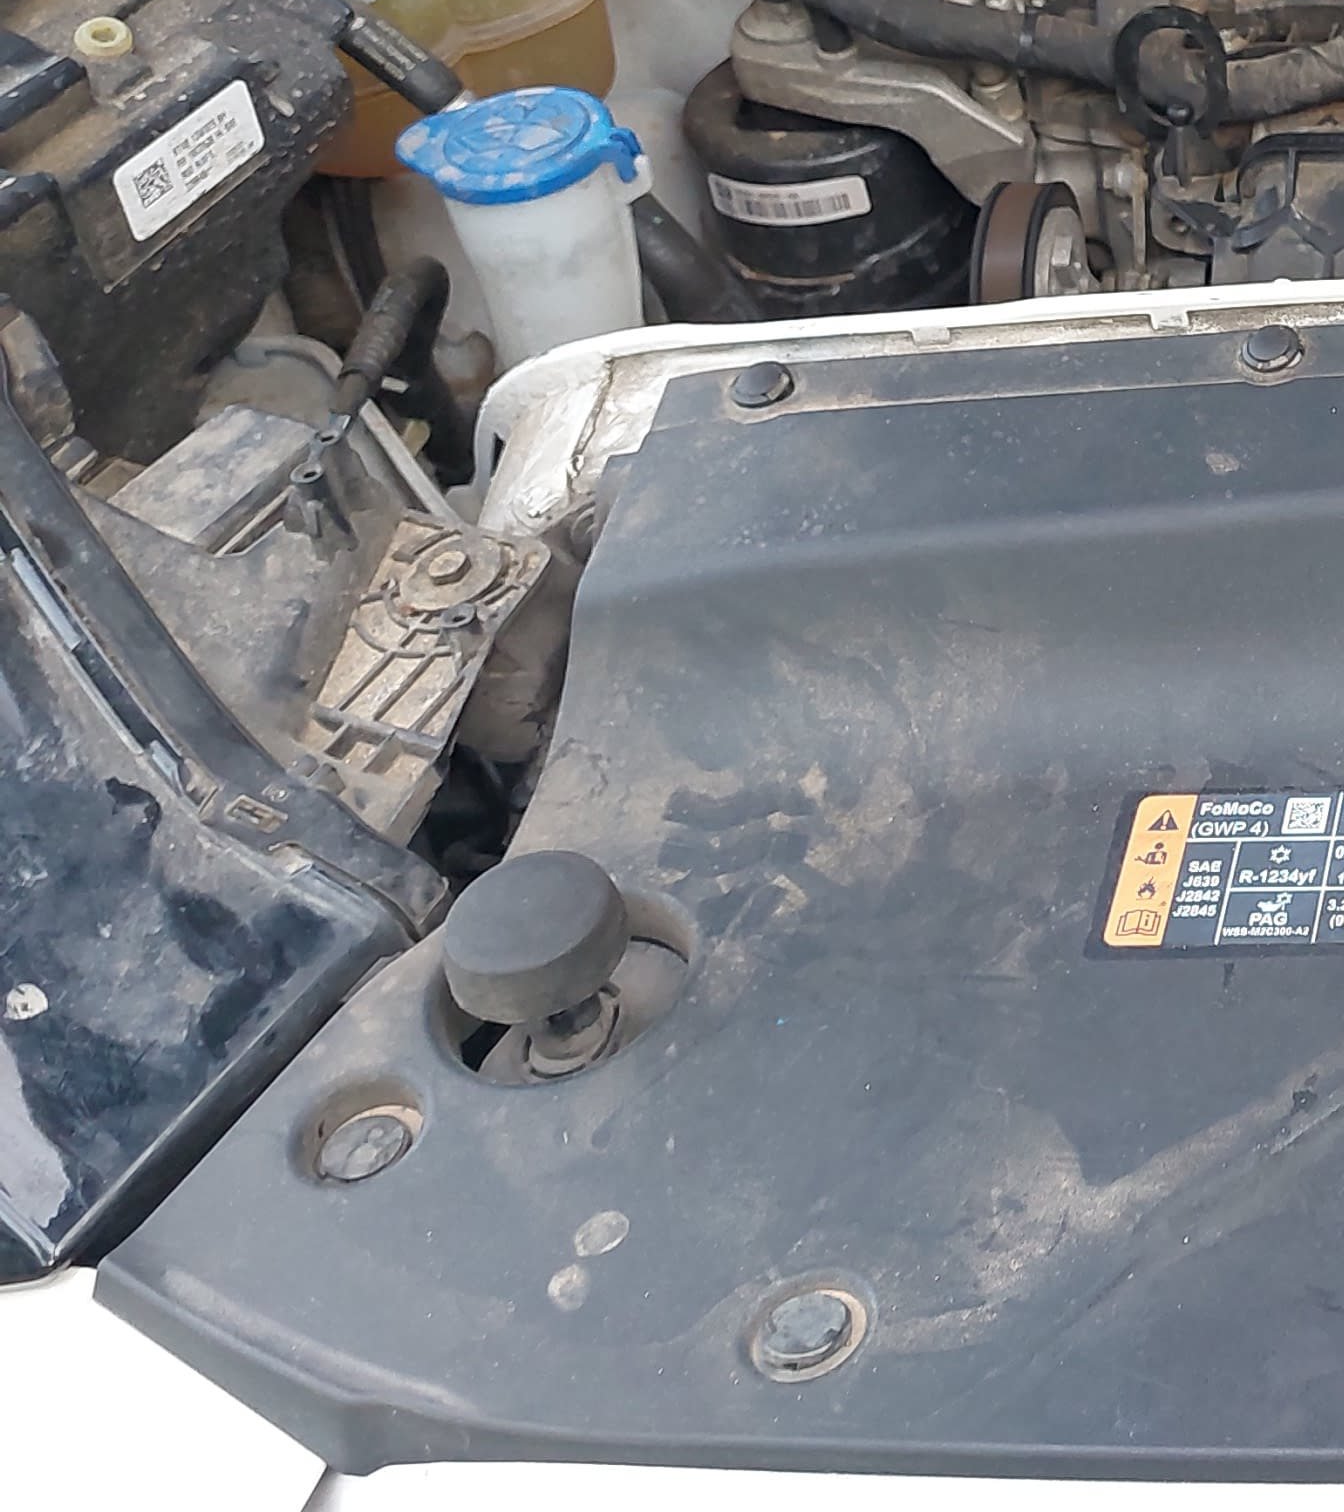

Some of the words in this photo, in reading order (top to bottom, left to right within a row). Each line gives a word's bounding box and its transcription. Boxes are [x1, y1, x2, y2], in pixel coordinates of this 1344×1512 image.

[1200, 801, 1274, 816] FoMoCo
[1191, 821, 1247, 838] (GWP
[1249, 821, 1269, 837] 4)
[1188, 860, 1222, 873] SAE
[1183, 875, 1220, 888] J639
[1239, 869, 1318, 885] R-1234yf
[1176, 890, 1221, 903] J2842
[1172, 905, 1217, 917] J2845
[1248, 913, 1288, 926] PAG
